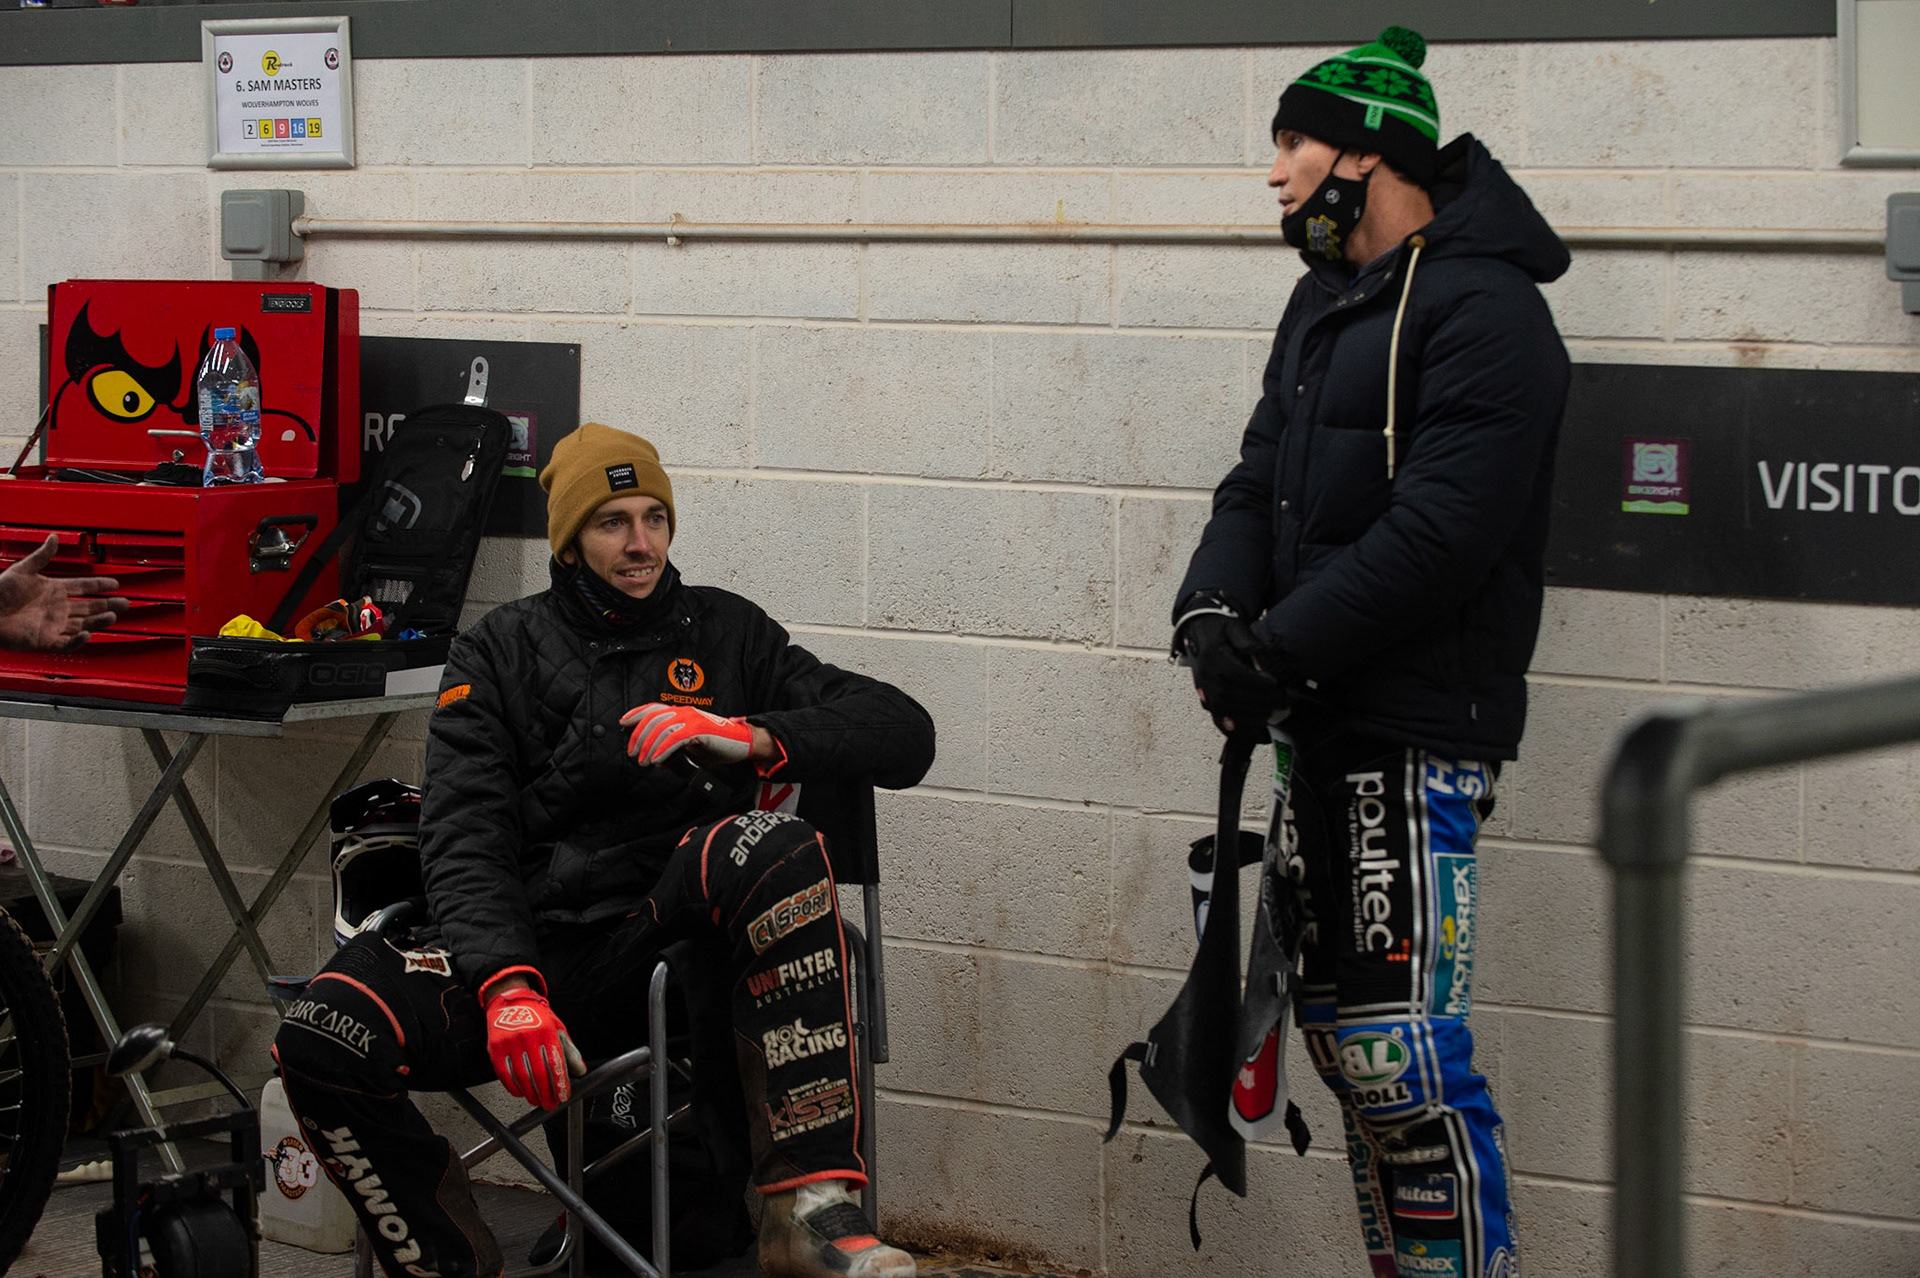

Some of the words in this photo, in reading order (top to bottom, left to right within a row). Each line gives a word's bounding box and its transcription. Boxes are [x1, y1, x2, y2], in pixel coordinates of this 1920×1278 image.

[236, 80, 245, 92] 6.
[248, 80, 271, 92] SAM
[274, 78, 322, 91] MASTERS
[241, 101, 295, 109] WOLVERHAMPTON
[296, 99, 319, 107] WOLVES
[247, 124, 253, 135] 2
[263, 123, 270, 135] 6
[279, 123, 286, 135] 9
[292, 122, 304, 134] 16
[309, 122, 320, 134] 19
[1757, 460, 1920, 516] VISITO
[660, 692, 714, 706] SPEEDWAY
[1345, 771, 1401, 952] poultec
[776, 890, 829, 930] SPORT
[1445, 862, 1471, 1015] MOTOREX
[747, 947, 836, 997] UNIFILTER
[755, 969, 840, 1010] AUSTRALIA
[765, 1027, 847, 1070] RACING
[1354, 1085, 1408, 1106] BOLL
